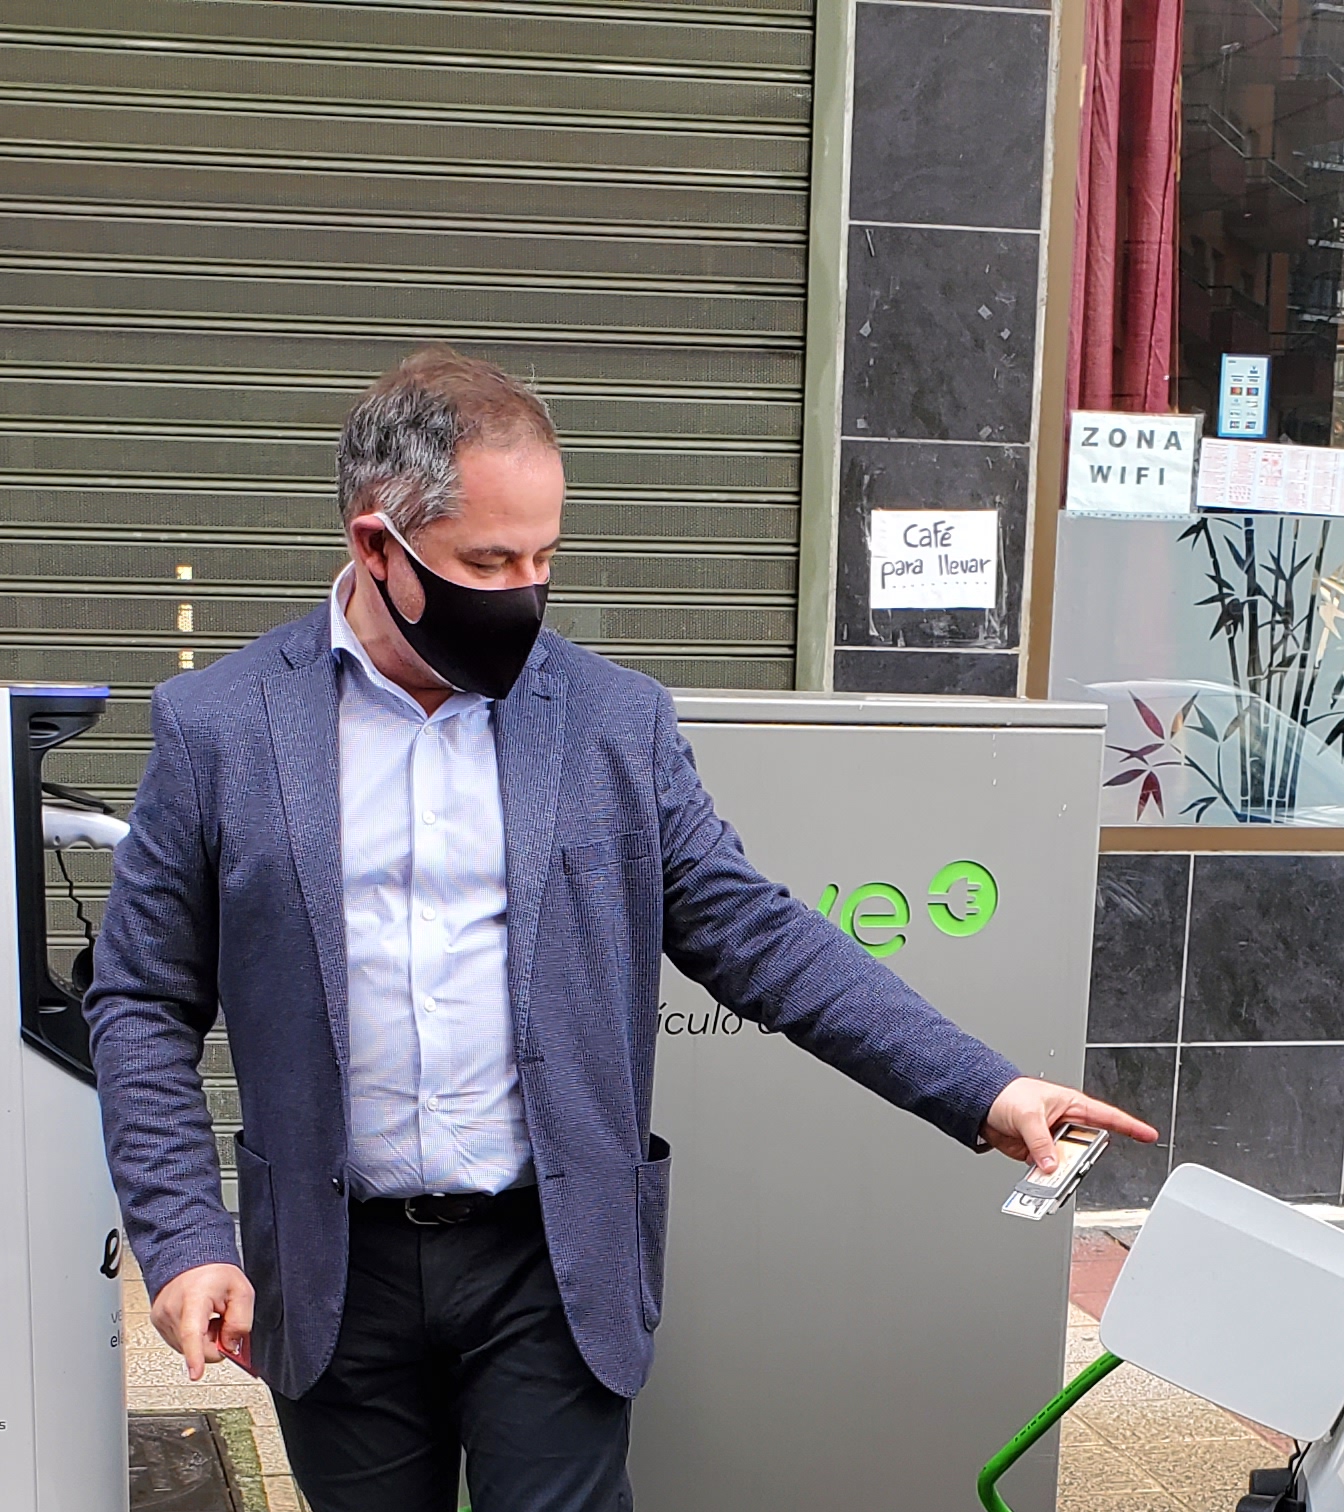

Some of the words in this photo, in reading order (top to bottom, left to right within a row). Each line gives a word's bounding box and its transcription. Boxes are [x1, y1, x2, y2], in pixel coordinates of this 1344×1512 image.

[1081, 426, 1183, 451] ZONA
[1089, 464, 1165, 486] WIFI
[881, 558, 924, 590] para
[938, 553, 992, 576] llevar
